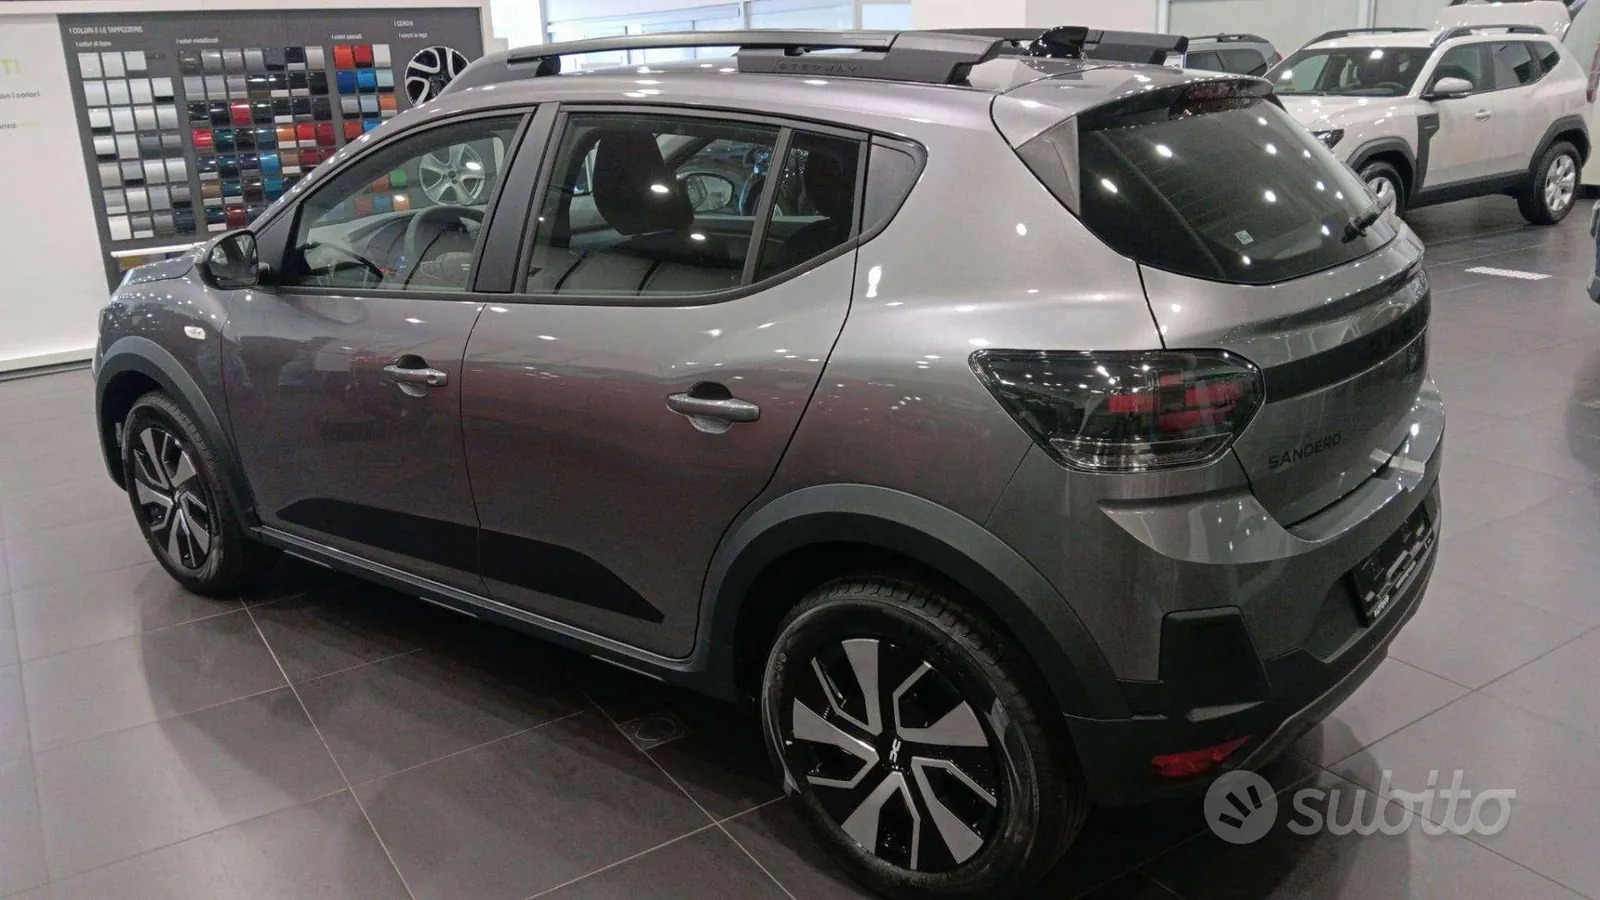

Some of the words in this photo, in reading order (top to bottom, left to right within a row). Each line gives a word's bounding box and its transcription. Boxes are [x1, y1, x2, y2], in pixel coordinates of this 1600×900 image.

[72, 26, 95, 34] COLORI
[15, 90, 41, 98] colori
[1268, 431, 1342, 470] SANDERO
